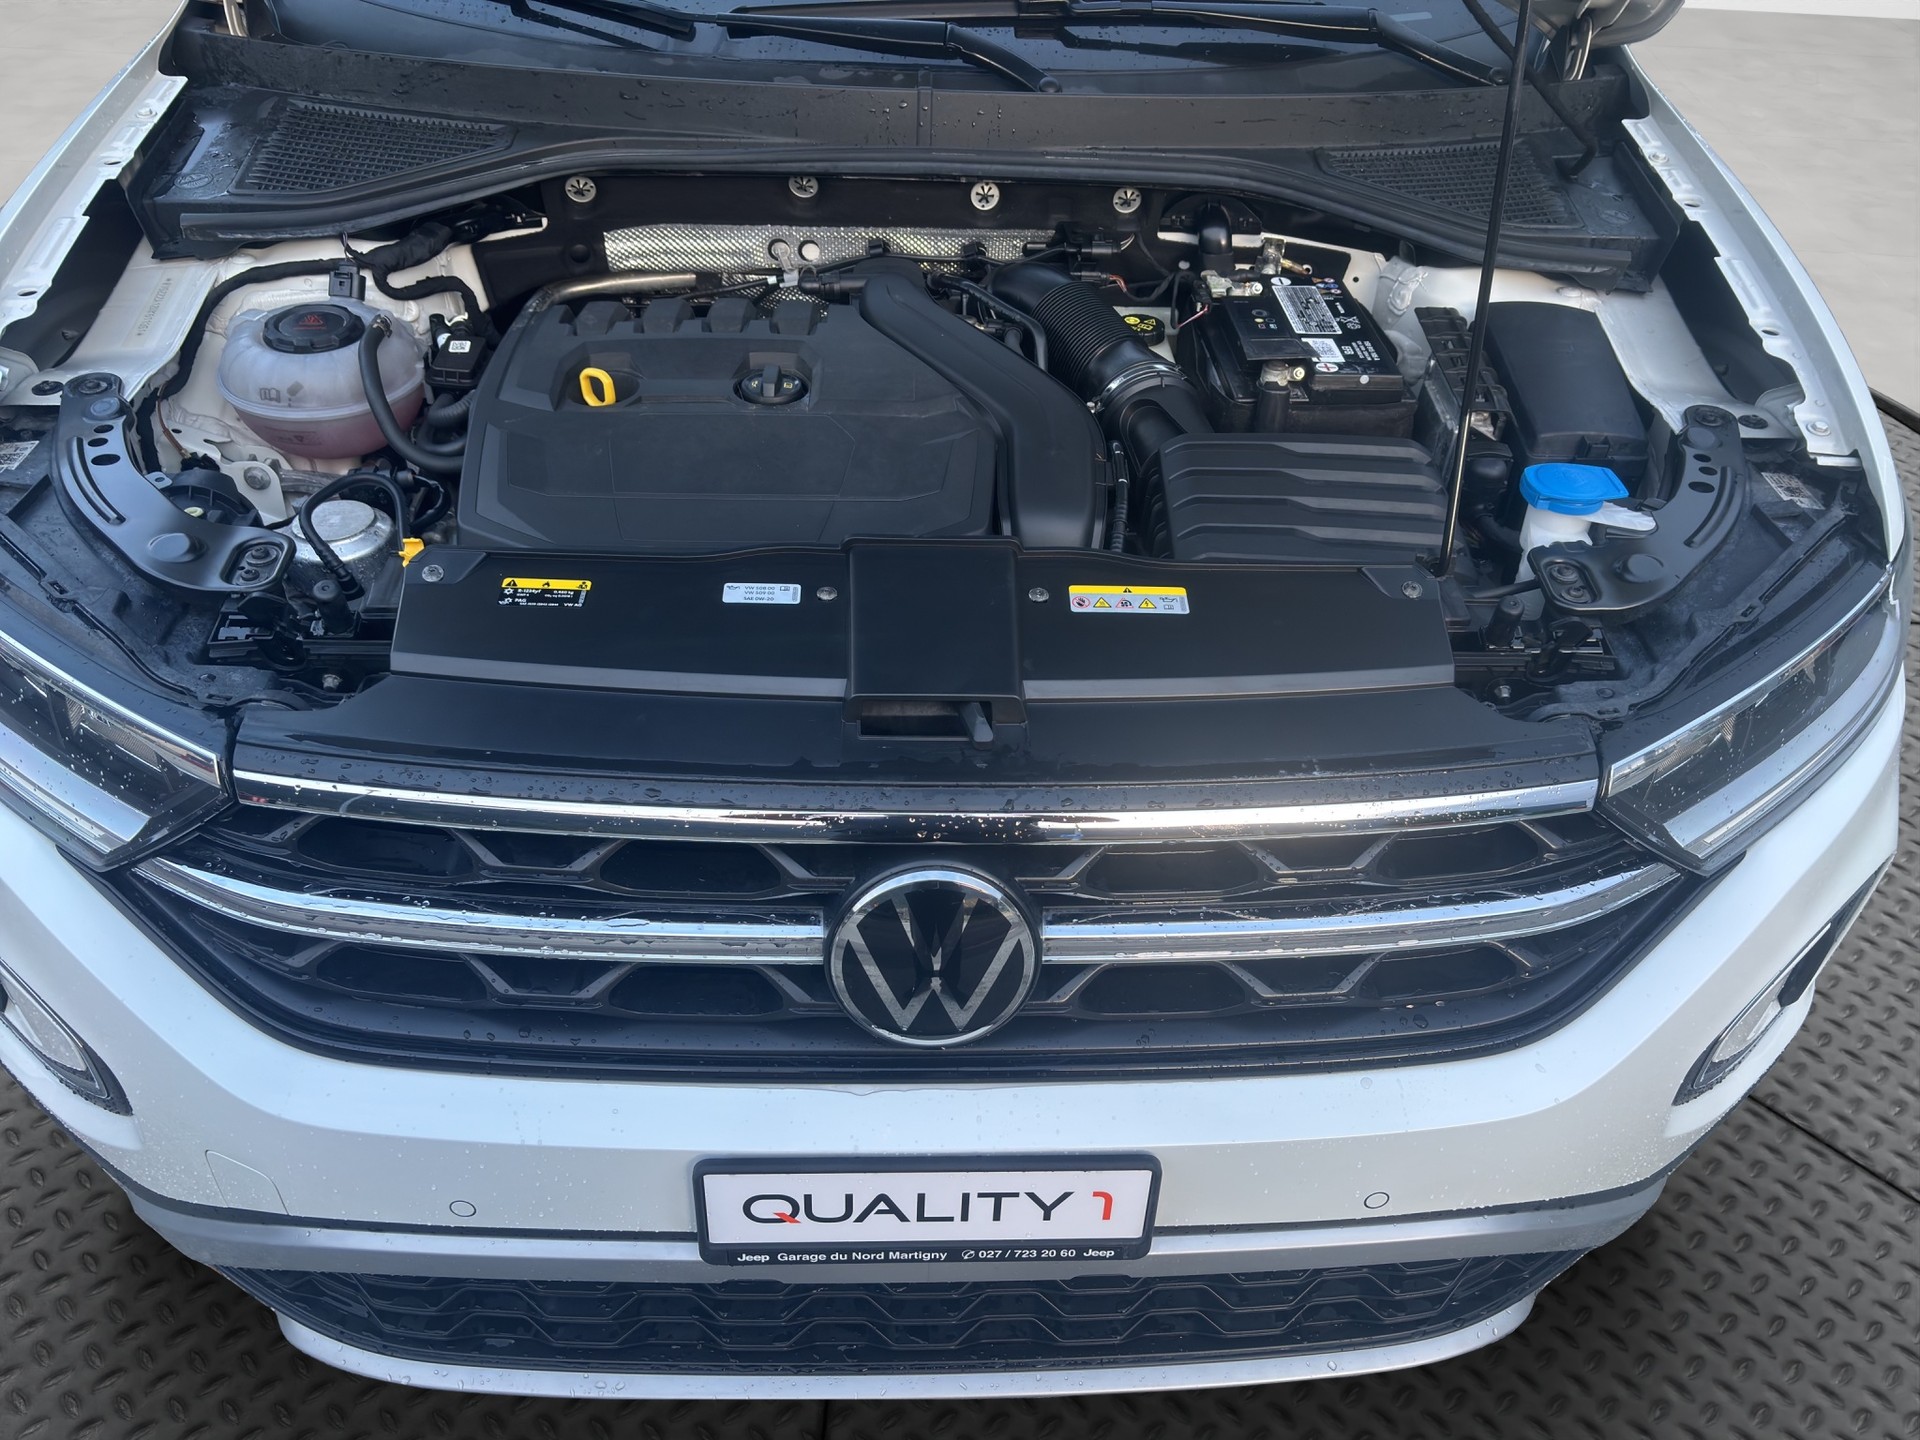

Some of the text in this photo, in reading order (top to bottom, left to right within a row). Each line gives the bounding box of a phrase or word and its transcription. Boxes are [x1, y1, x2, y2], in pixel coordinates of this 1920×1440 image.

[742, 1191, 1113, 1224] QUALITY 1
[737, 1253, 770, 1263] Jeep
[777, 1252, 827, 1262] Garage
[830, 1252, 848, 1261] du
[852, 1251, 885, 1260] Nord
[888, 1250, 948, 1261] Martigny
[978, 1249, 1002, 1258] 027
[1014, 1249, 1037, 1258] 723
[1041, 1249, 1056, 1258] 20
[1060, 1249, 1076, 1257] 60
[1083, 1248, 1115, 1259] Jeep
